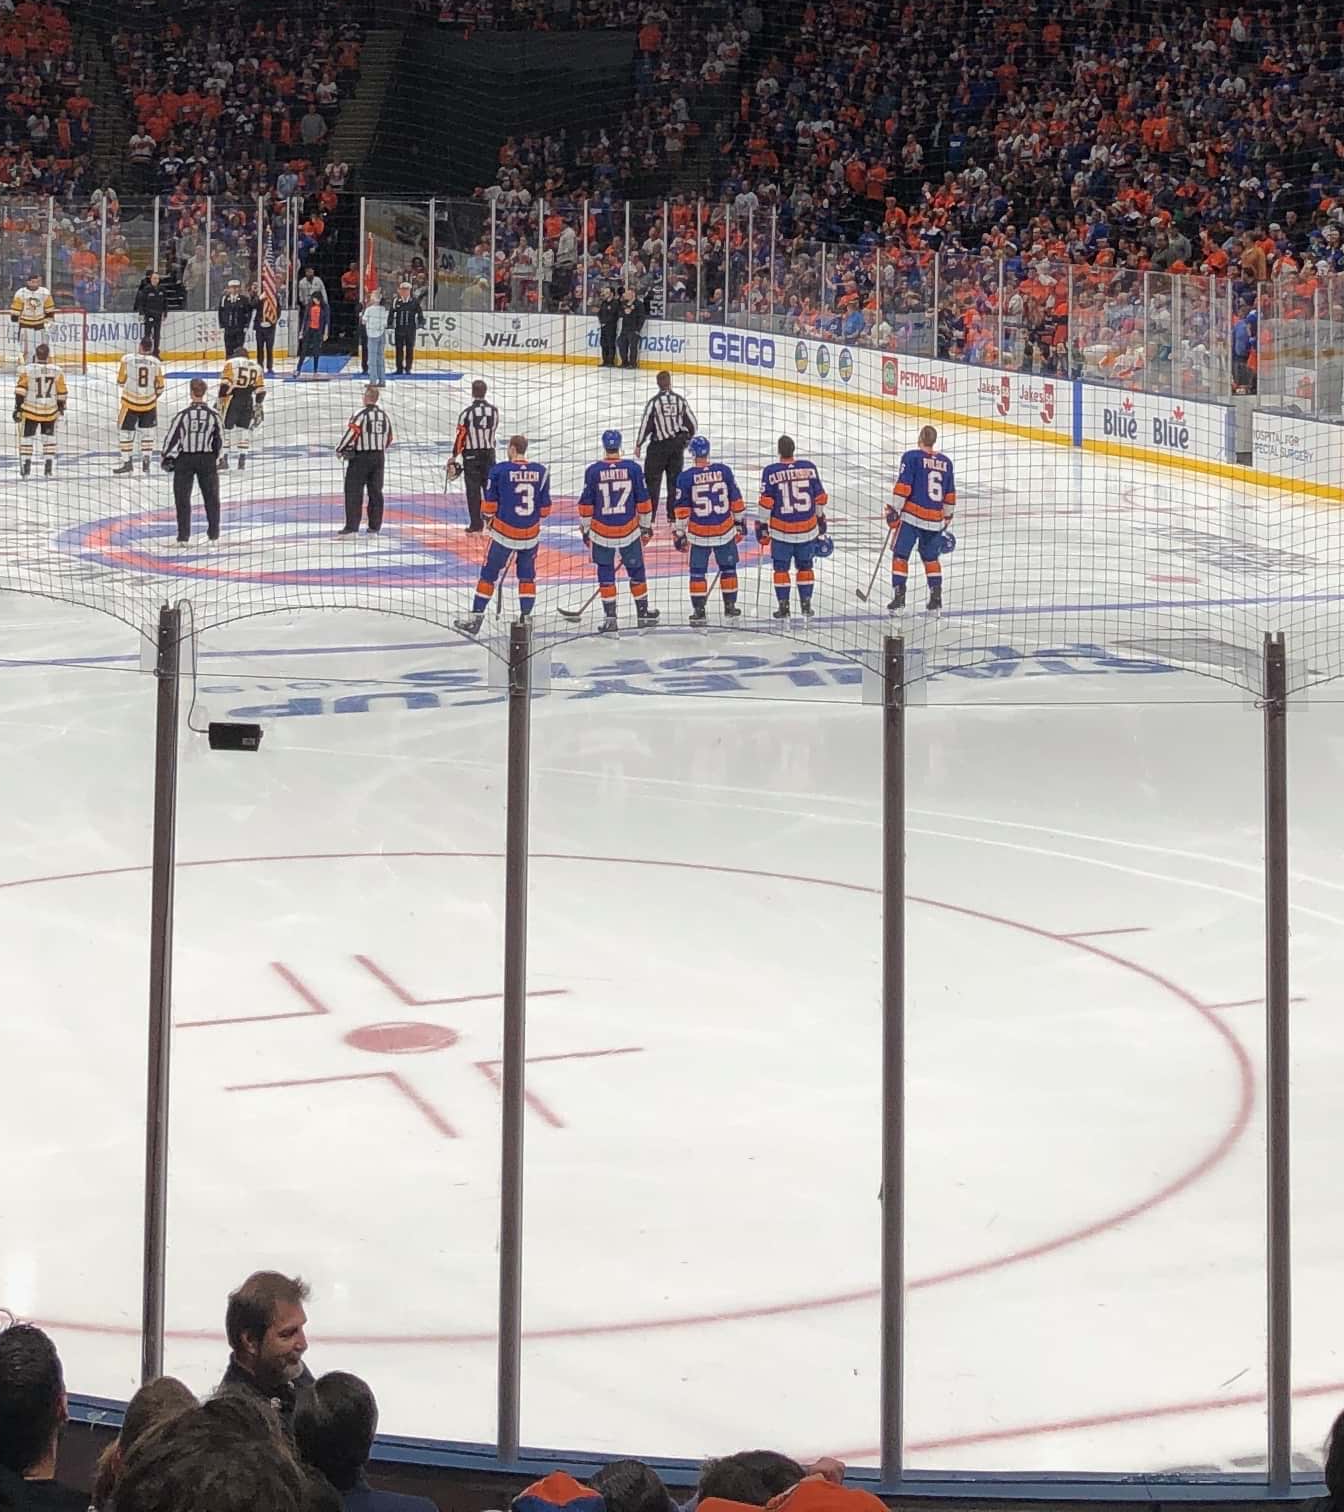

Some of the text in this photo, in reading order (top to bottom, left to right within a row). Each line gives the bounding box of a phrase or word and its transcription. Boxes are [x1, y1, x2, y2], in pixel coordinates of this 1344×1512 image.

[484, 333, 548, 349] NHL.COM
[709, 331, 775, 368] GEICO
[35, 377, 54, 398] 17
[138, 367, 149, 388] 8
[900, 370, 948, 393] PETROLEUM
[1103, 409, 1138, 440] Blue
[1153, 417, 1189, 449] Blue
[1256, 429, 1284, 443] OSPITAL
[1256, 445, 1280, 457] PECIAL
[599, 468, 629, 481] MARTIN
[927, 471, 944, 502] 6
[514, 483, 535, 516] 3
[599, 481, 633, 515] 17
[691, 482, 729, 517] 53
[778, 480, 812, 514] 15
